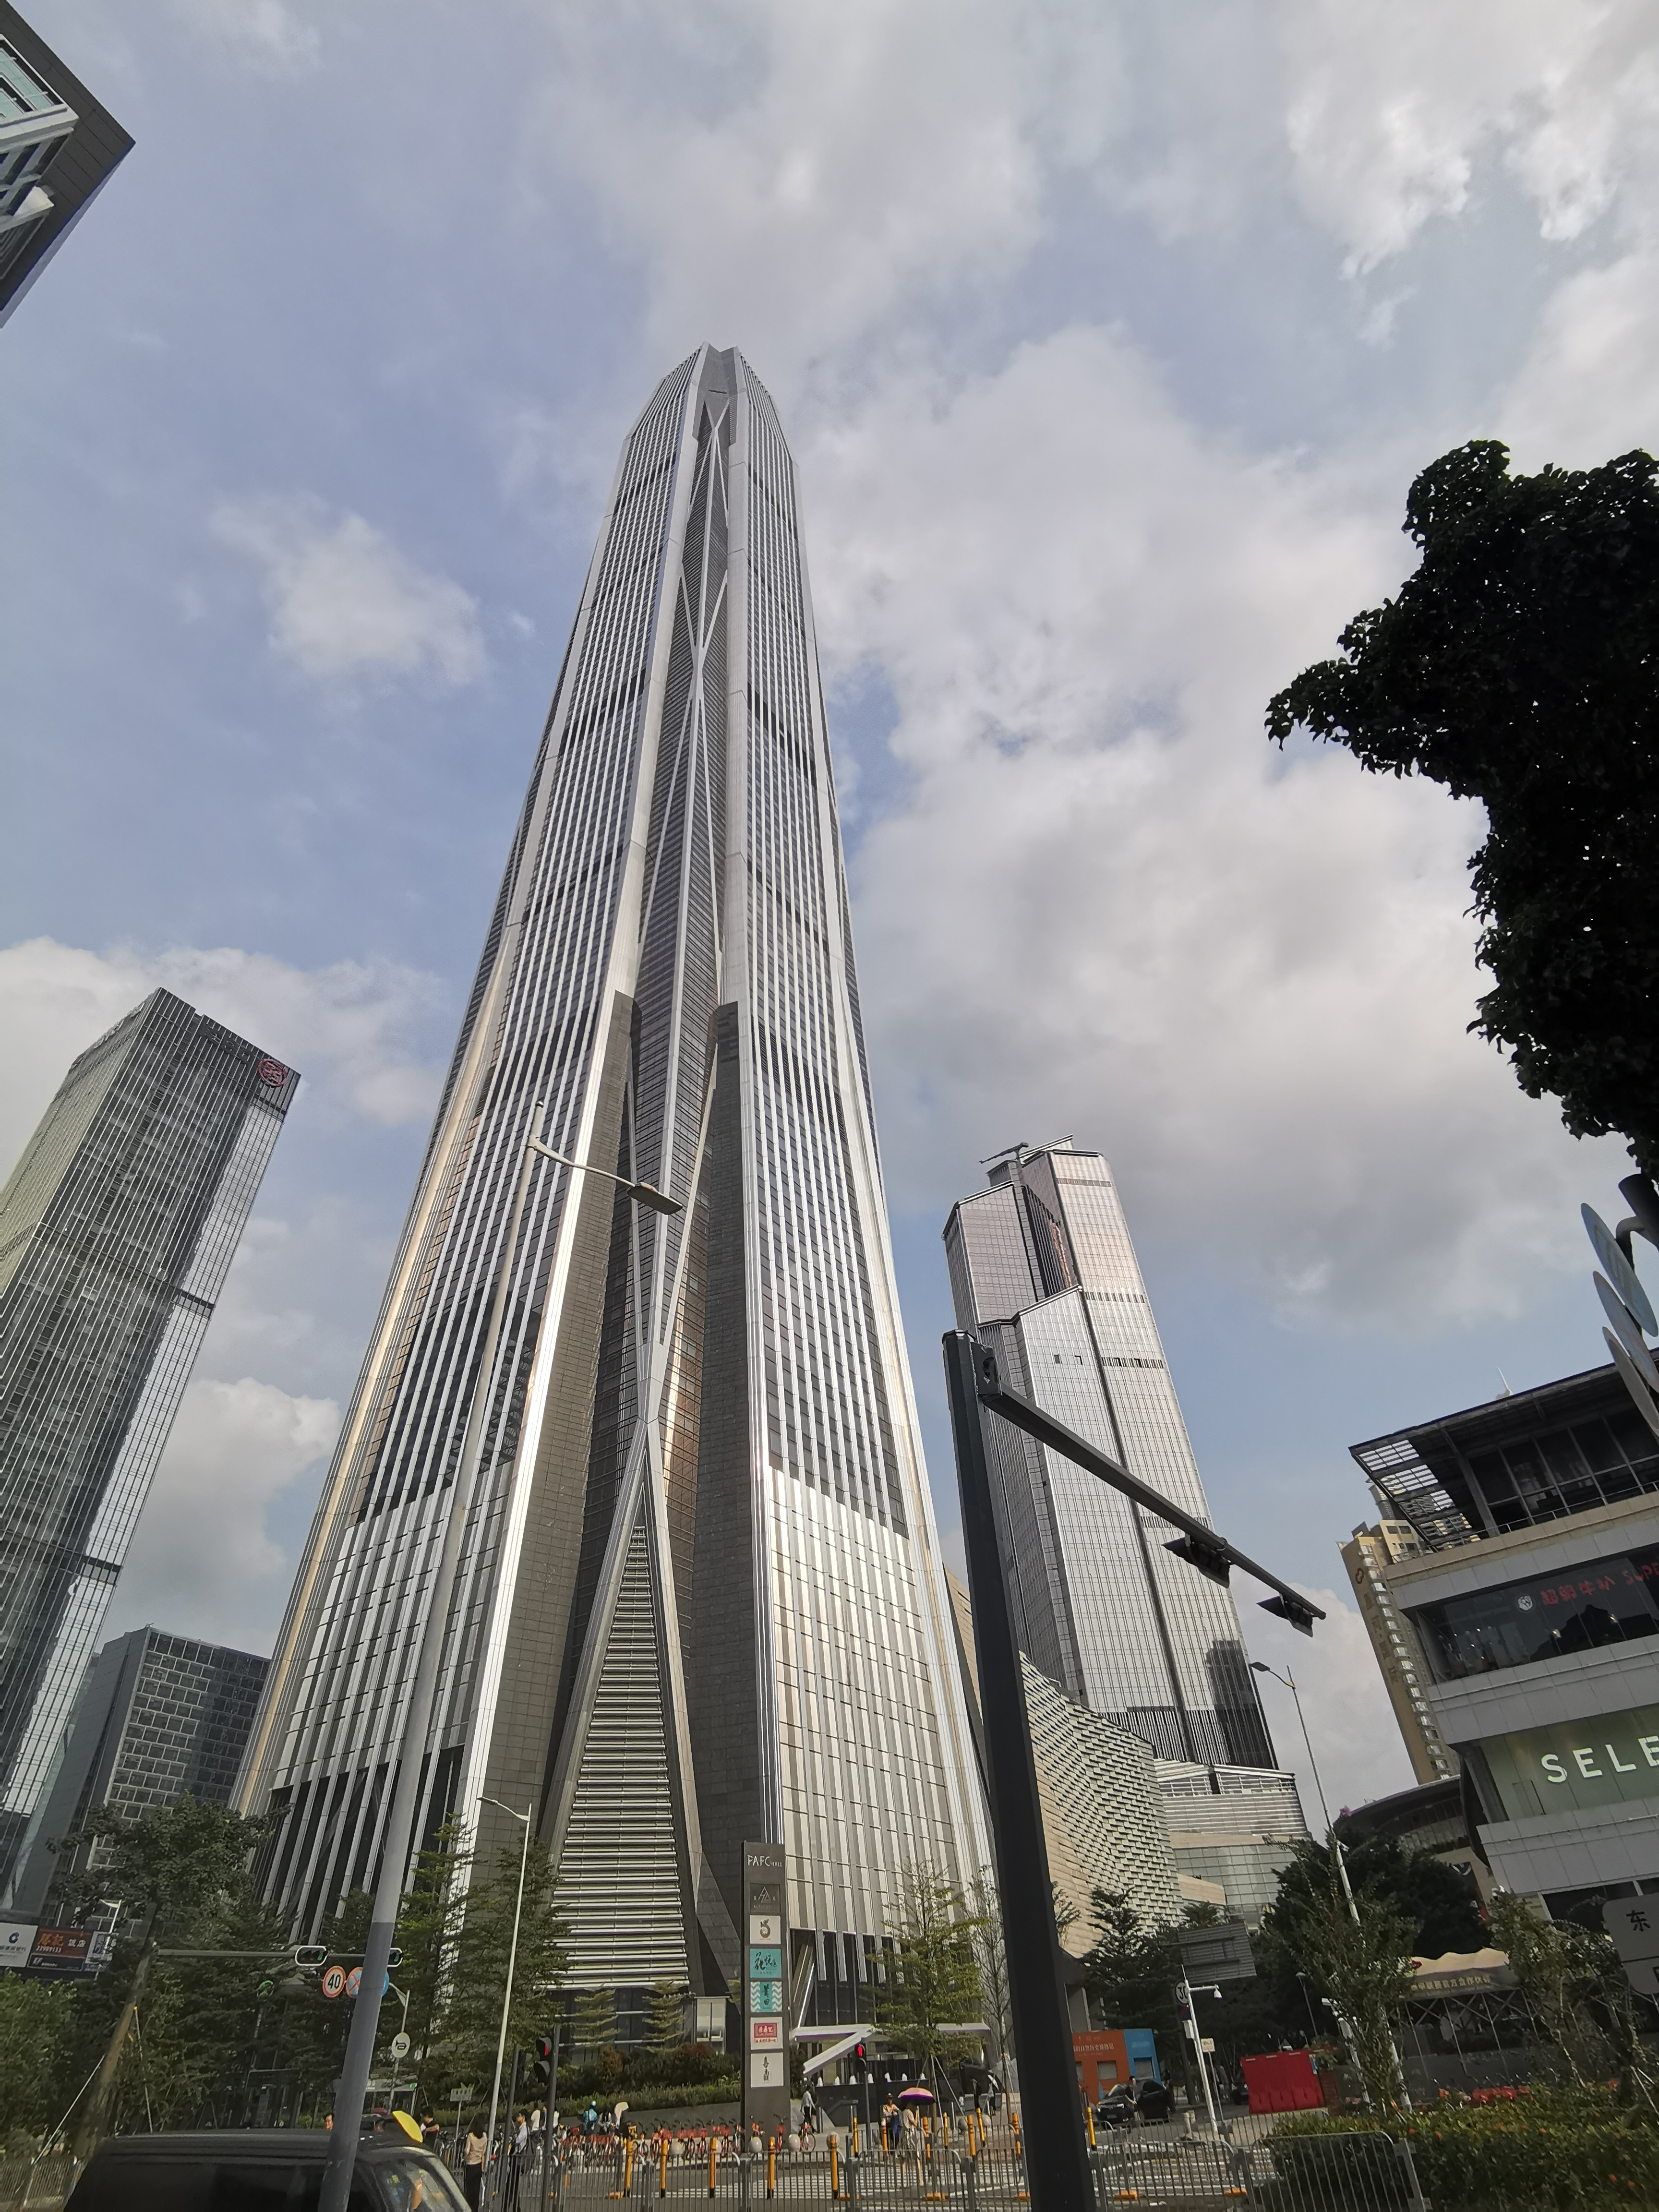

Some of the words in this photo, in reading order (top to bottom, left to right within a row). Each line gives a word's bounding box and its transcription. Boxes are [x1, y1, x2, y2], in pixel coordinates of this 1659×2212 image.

[1541, 1735, 1659, 1783] SELE
[1626, 1910, 1650, 1932] 东
[327, 1974, 341, 1989] 40
